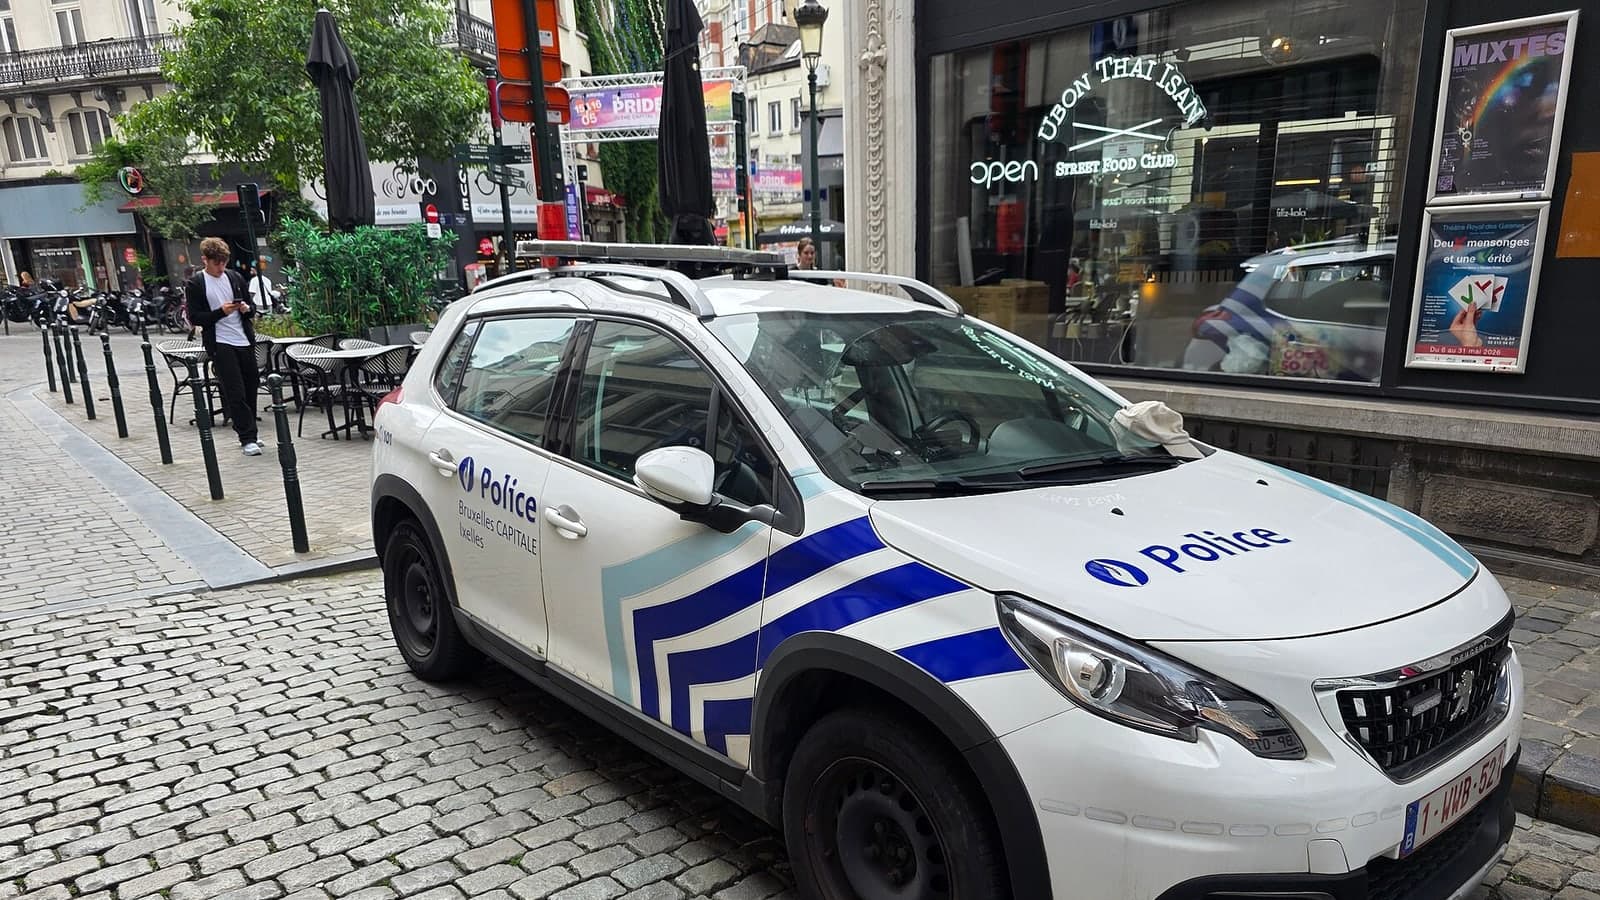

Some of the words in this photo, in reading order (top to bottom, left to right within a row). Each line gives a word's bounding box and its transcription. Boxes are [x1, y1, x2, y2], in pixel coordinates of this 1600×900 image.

[1453, 32, 1566, 66] MIXTES
[612, 96, 662, 115] PRIDE
[1038, 73, 1092, 141] UBON
[1095, 56, 1157, 83] THAI
[1155, 62, 1207, 125] ISAN
[1055, 161, 1100, 177] STREET
[1102, 157, 1137, 172] FOOD
[1140, 153, 1175, 168] CLUB
[1466, 239, 1530, 248] mensonges
[1443, 254, 1454, 263] et
[1482, 348, 1501, 356] 2026
[480, 467, 537, 523] Police
[459, 500, 495, 532] Bruxelles
[496, 520, 537, 556] CAPITALE
[459, 522, 485, 549] Ixelles
[1139, 528, 1292, 573] Police
[1405, 832, 1413, 850] B
